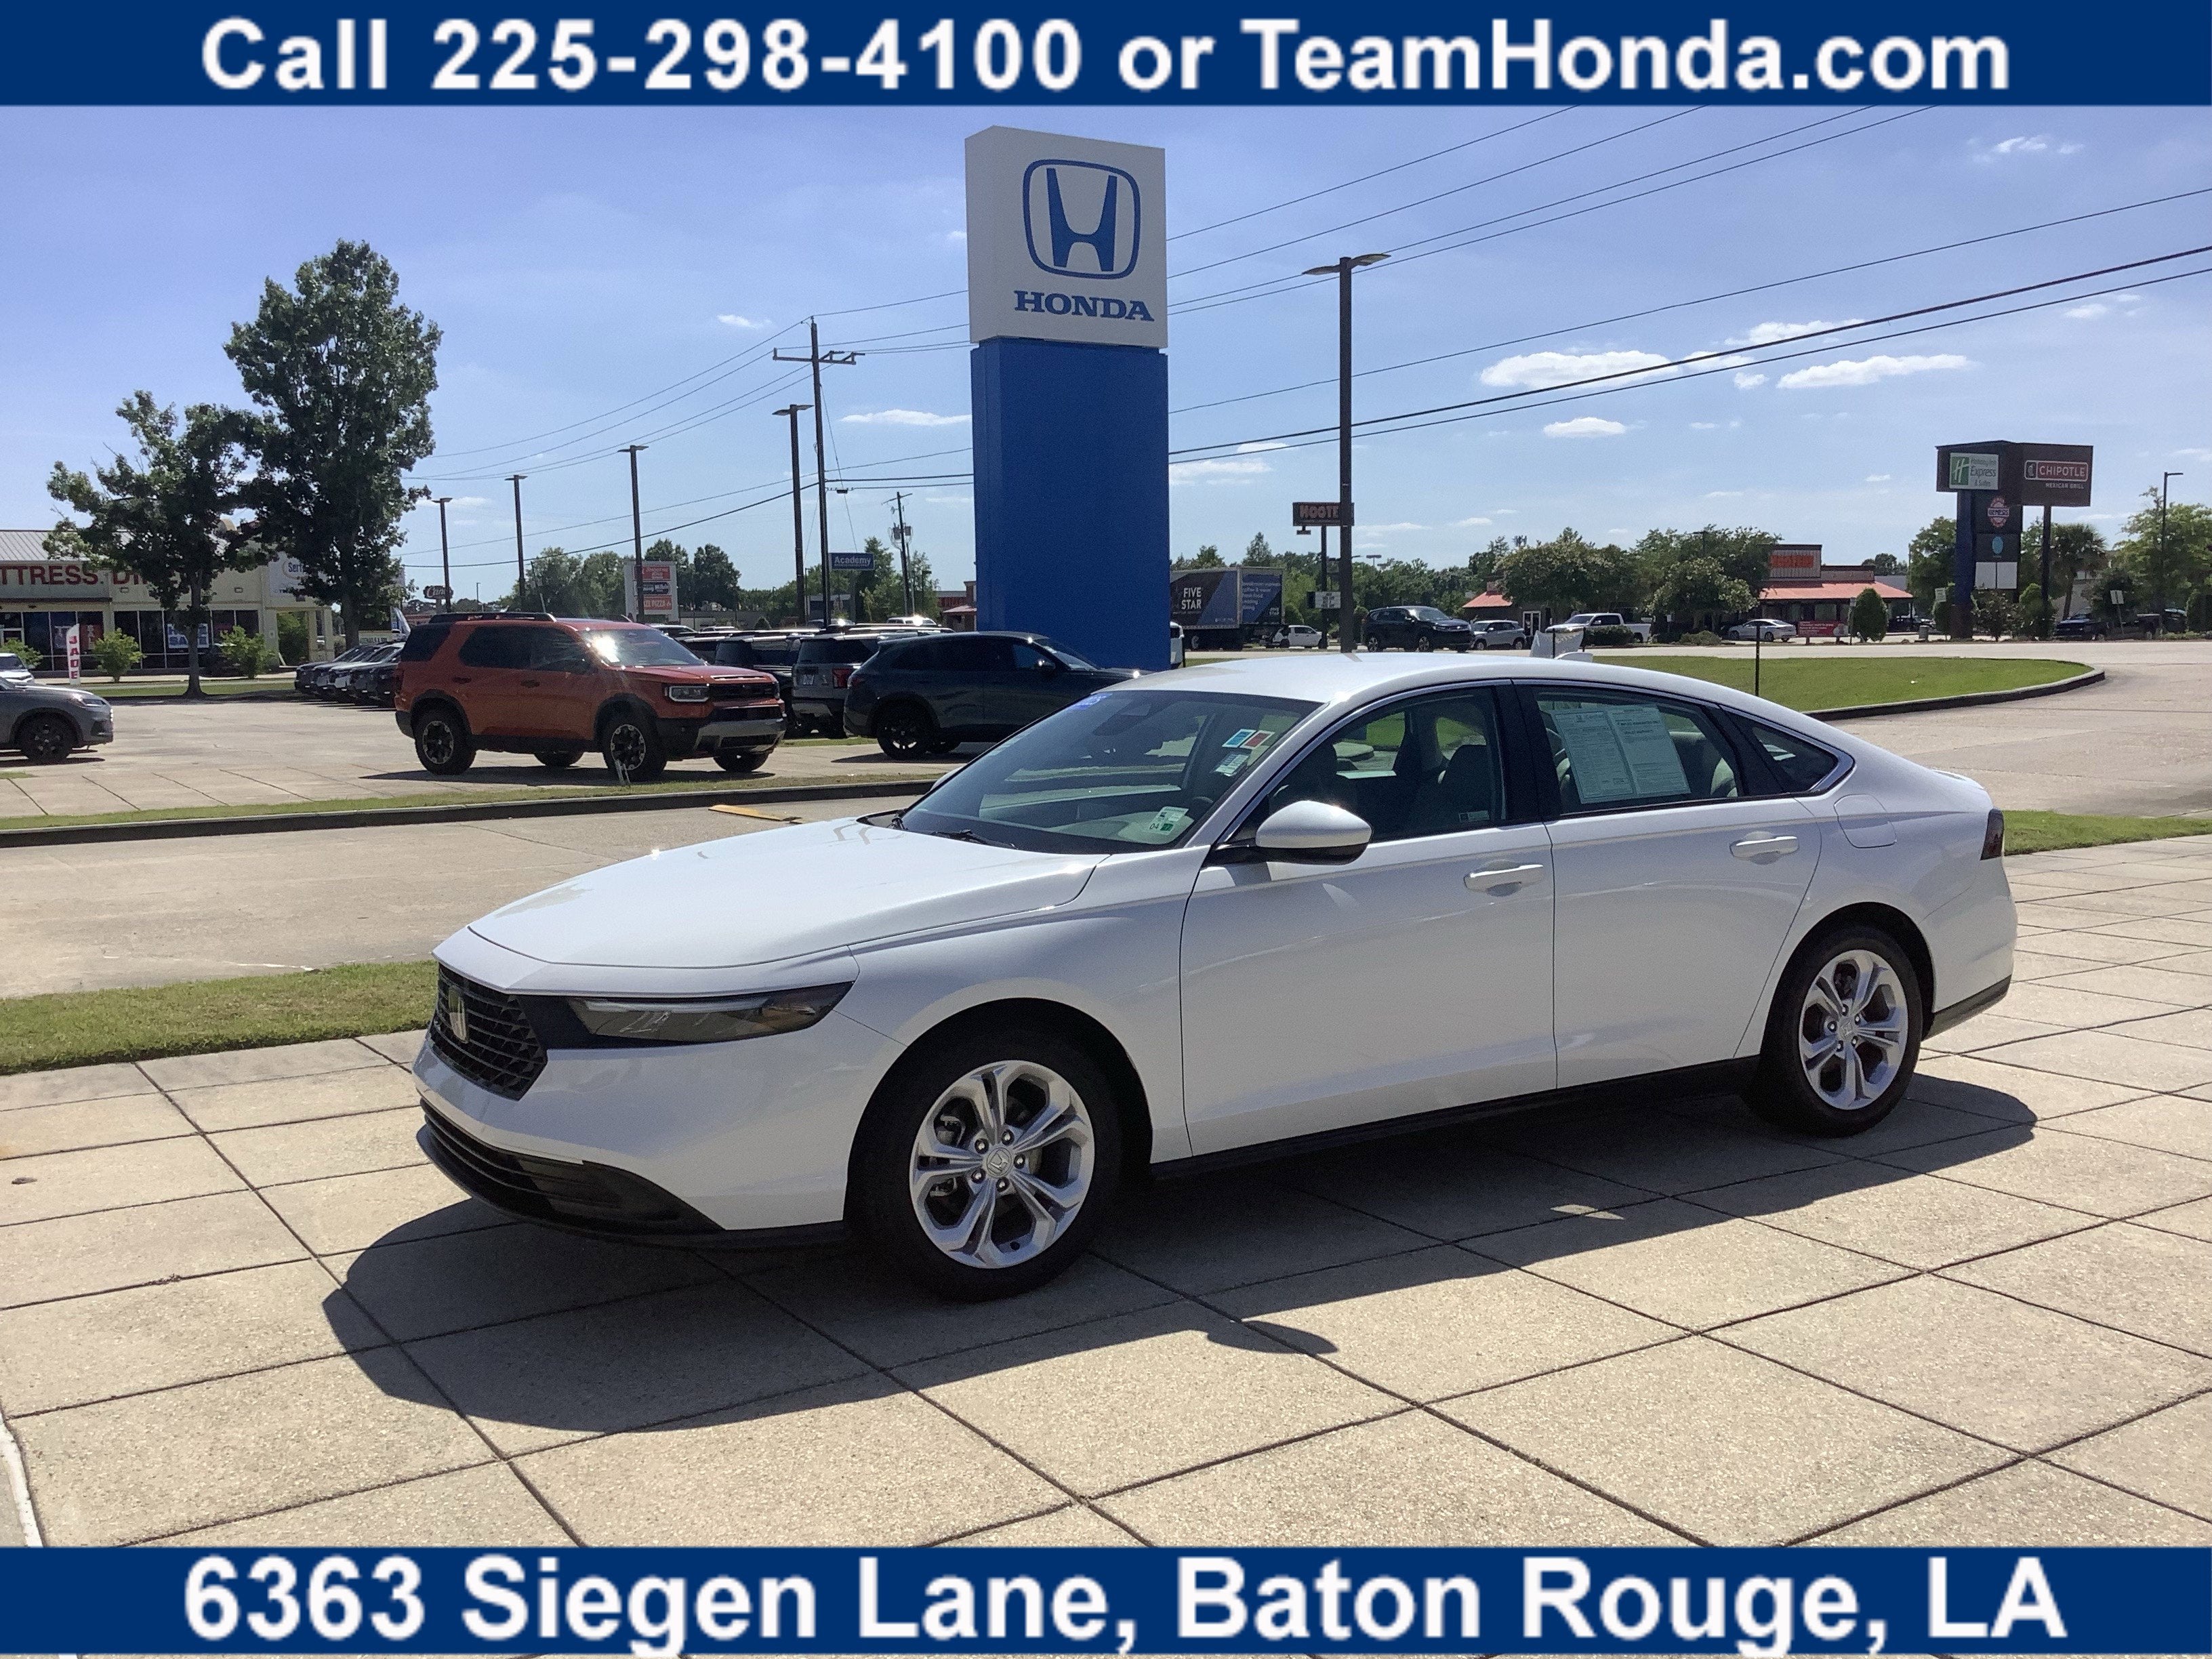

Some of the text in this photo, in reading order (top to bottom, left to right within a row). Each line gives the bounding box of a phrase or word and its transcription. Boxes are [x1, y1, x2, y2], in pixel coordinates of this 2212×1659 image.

[1014, 289, 1155, 322] HONDA
[1971, 466, 1996, 478] Express
[2039, 465, 2085, 477] CHIPOTLE
[834, 556, 871, 565] Academy
[1183, 587, 1202, 598] FIVE
[1181, 599, 1202, 610] STAR
